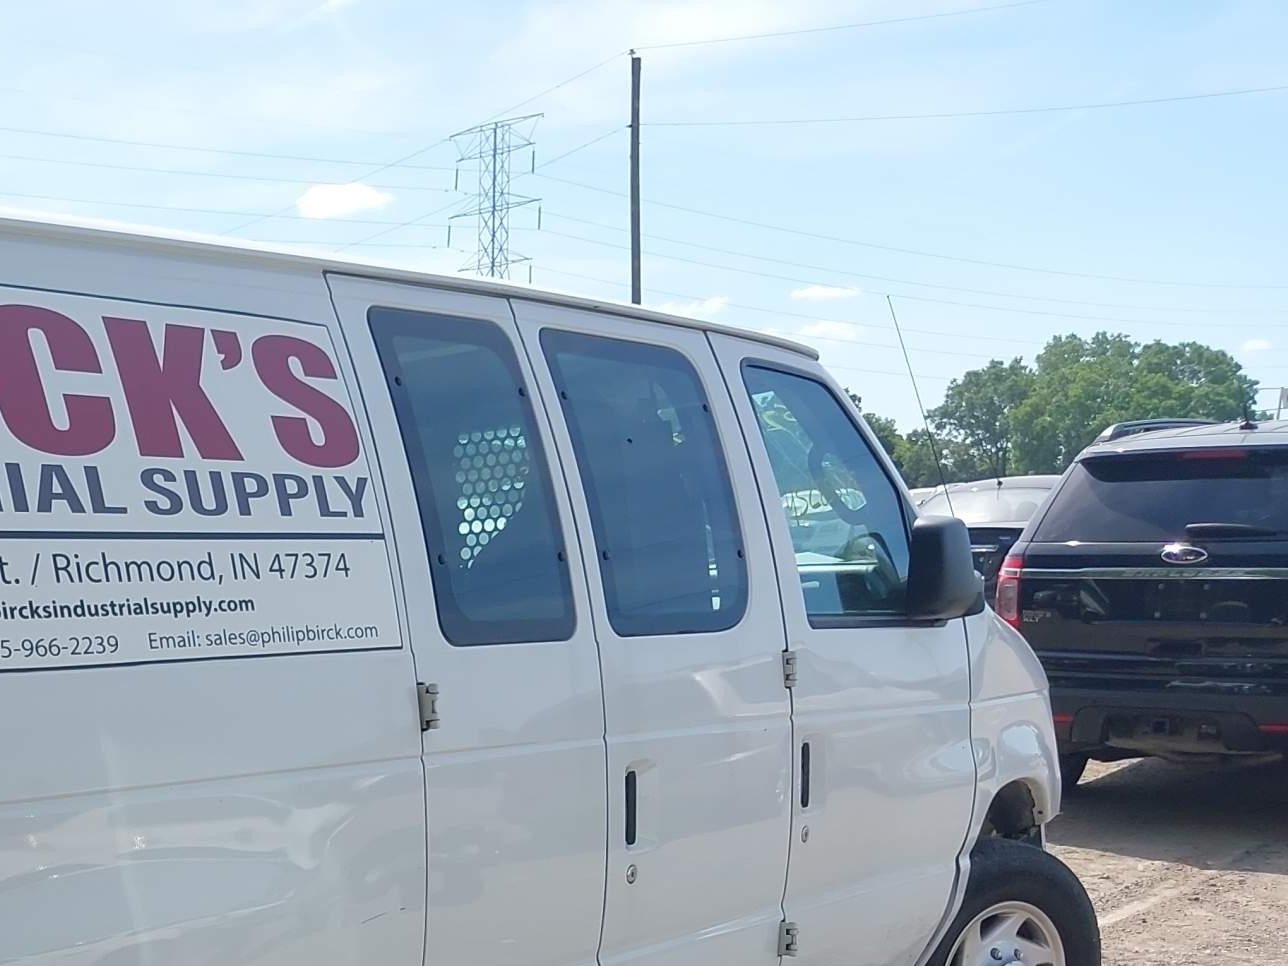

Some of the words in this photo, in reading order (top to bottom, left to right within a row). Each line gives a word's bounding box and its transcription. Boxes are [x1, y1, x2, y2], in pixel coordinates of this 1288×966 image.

[138, 467, 368, 519] SUPPLY
[30, 552, 41, 585] /
[51, 551, 225, 585] Richmond,
[231, 552, 262, 581] IN
[268, 551, 351, 580] 47374
[147, 630, 202, 651] Email:
[205, 623, 379, 648] sales@philipbirck.com
